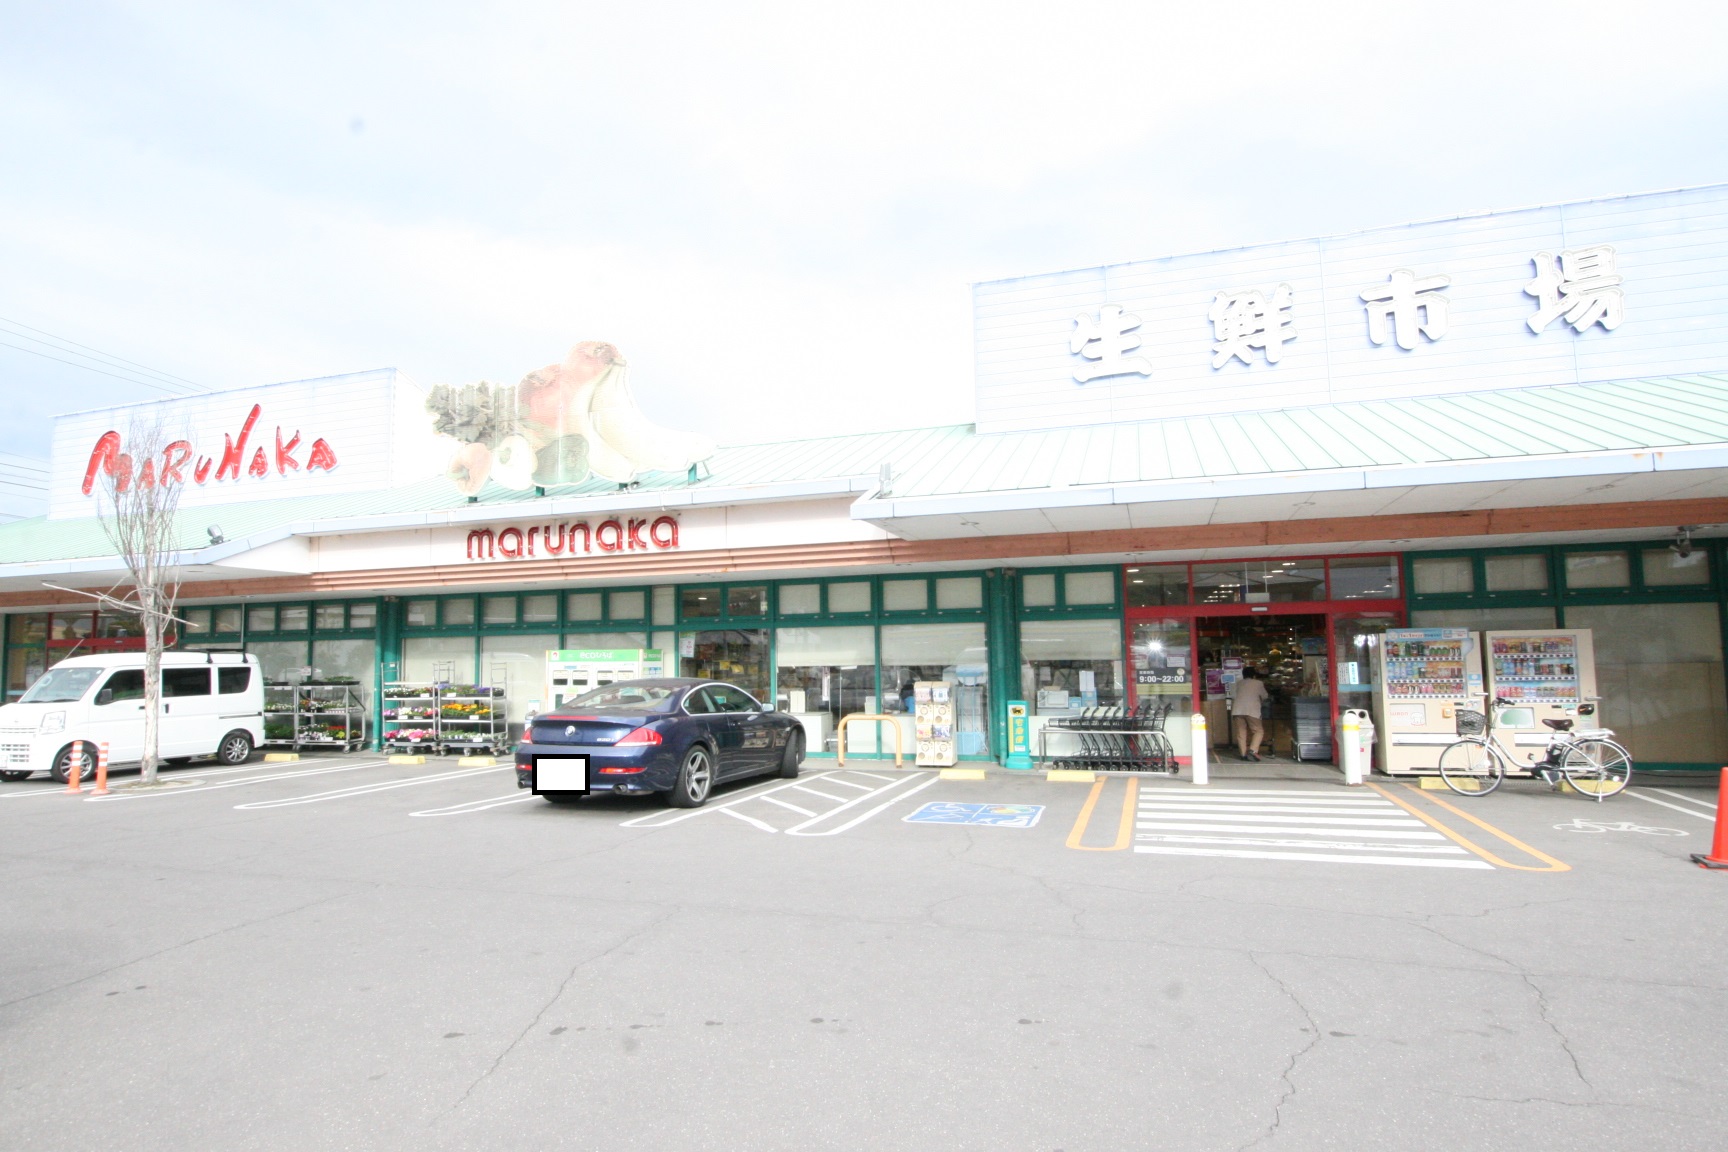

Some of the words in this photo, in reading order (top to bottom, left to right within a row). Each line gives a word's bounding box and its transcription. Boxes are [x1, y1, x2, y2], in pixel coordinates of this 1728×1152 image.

[1070, 243, 1626, 384] 生鮮市場
[467, 515, 679, 558] marunaka
